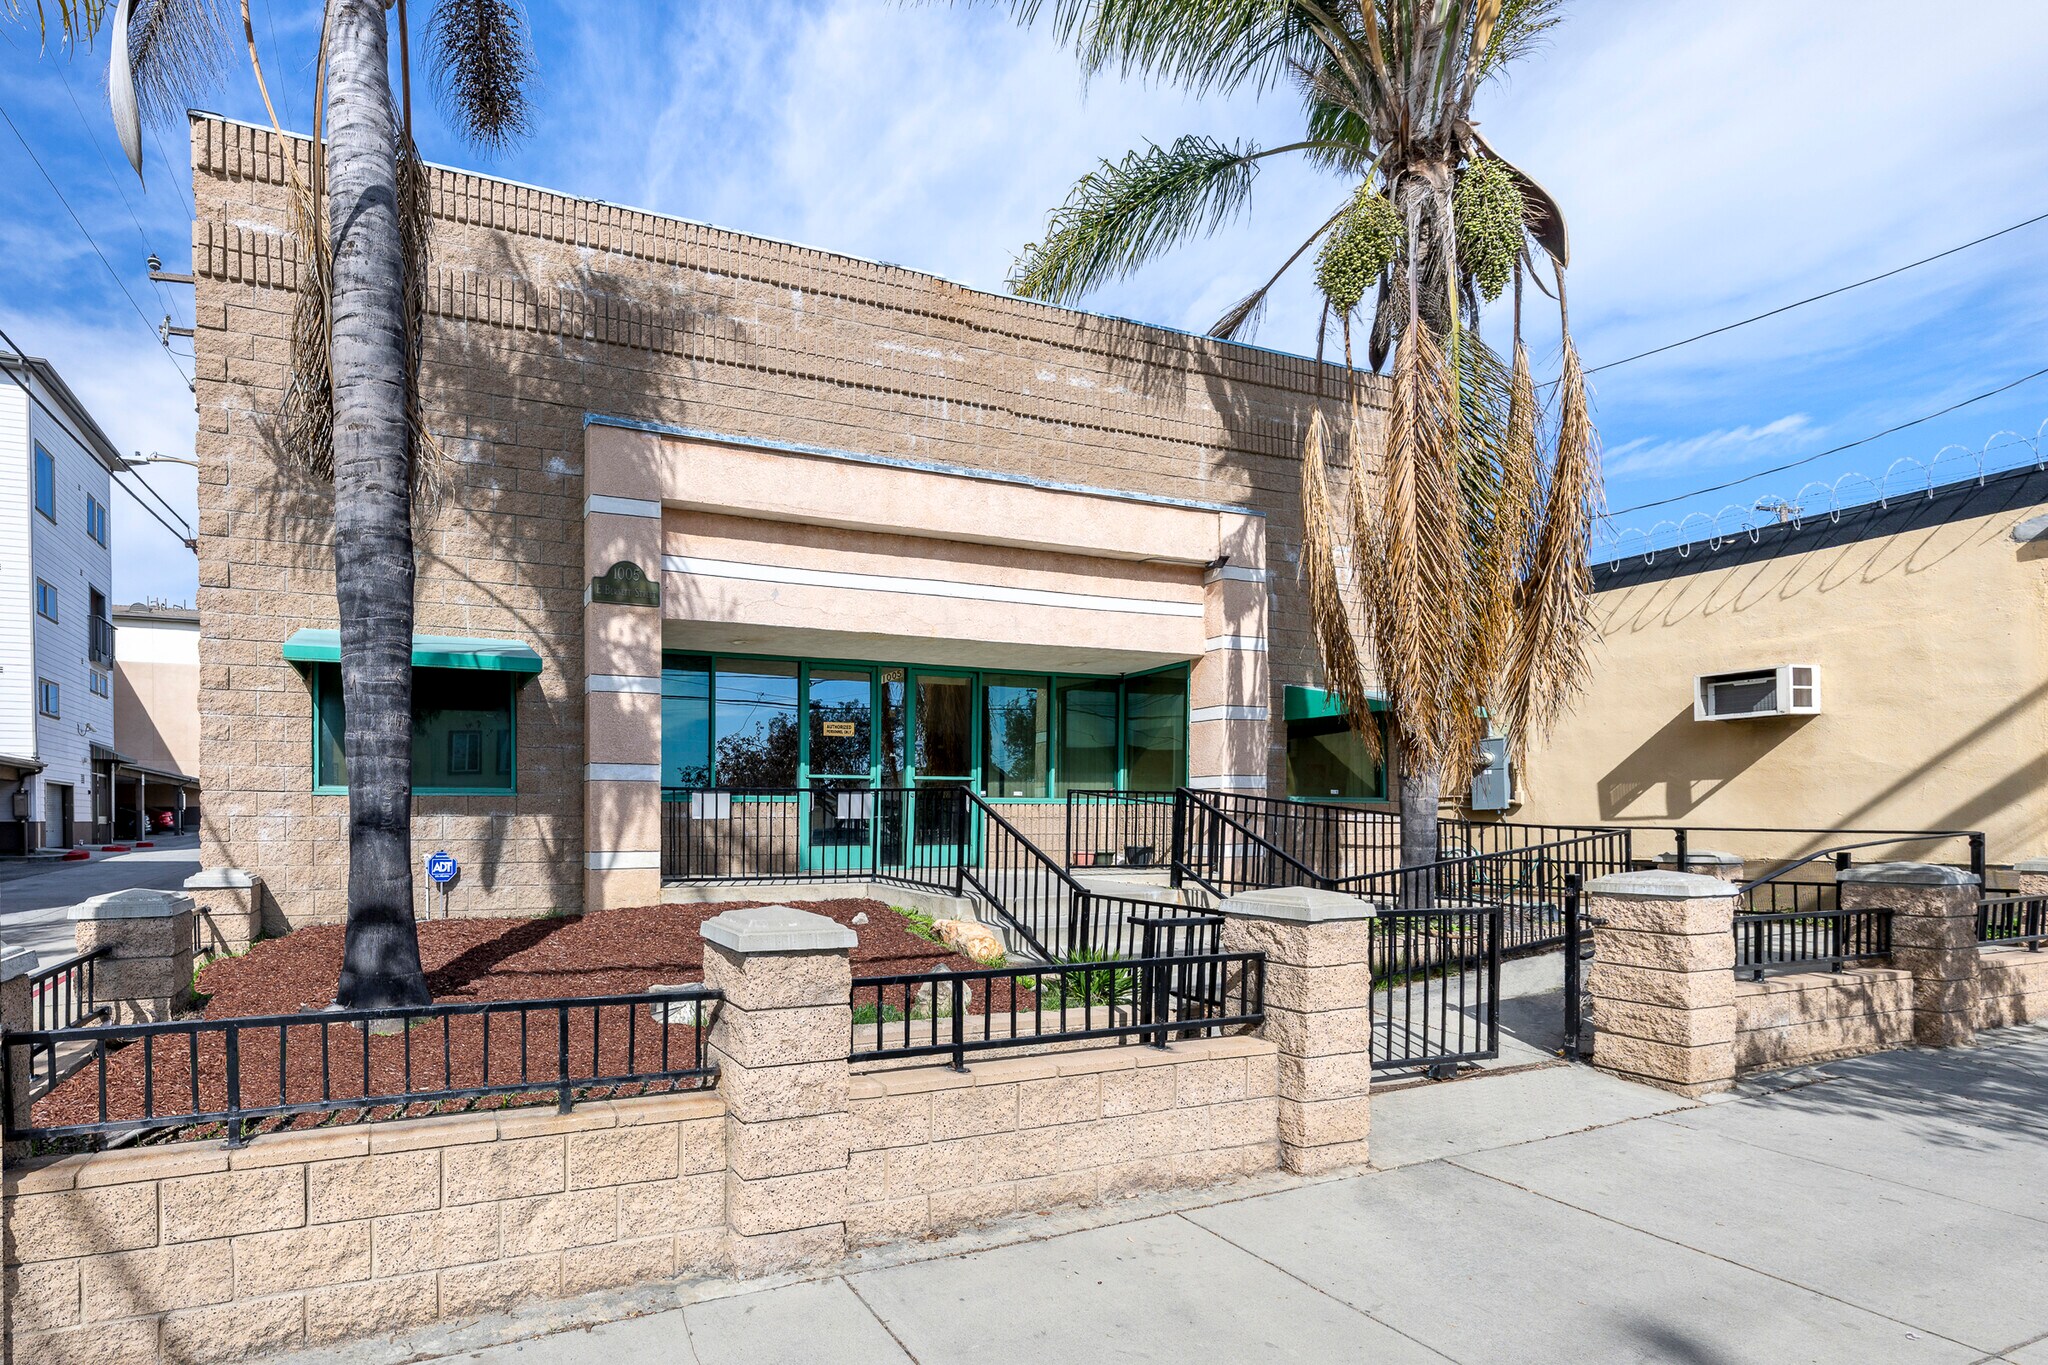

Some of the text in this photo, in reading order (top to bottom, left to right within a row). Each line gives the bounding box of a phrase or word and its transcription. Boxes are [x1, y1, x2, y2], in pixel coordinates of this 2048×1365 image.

[614, 567, 640, 581] 1005
[596, 584, 602, 594] E
[882, 669, 902, 682] 1005
[432, 861, 453, 873] ADT
